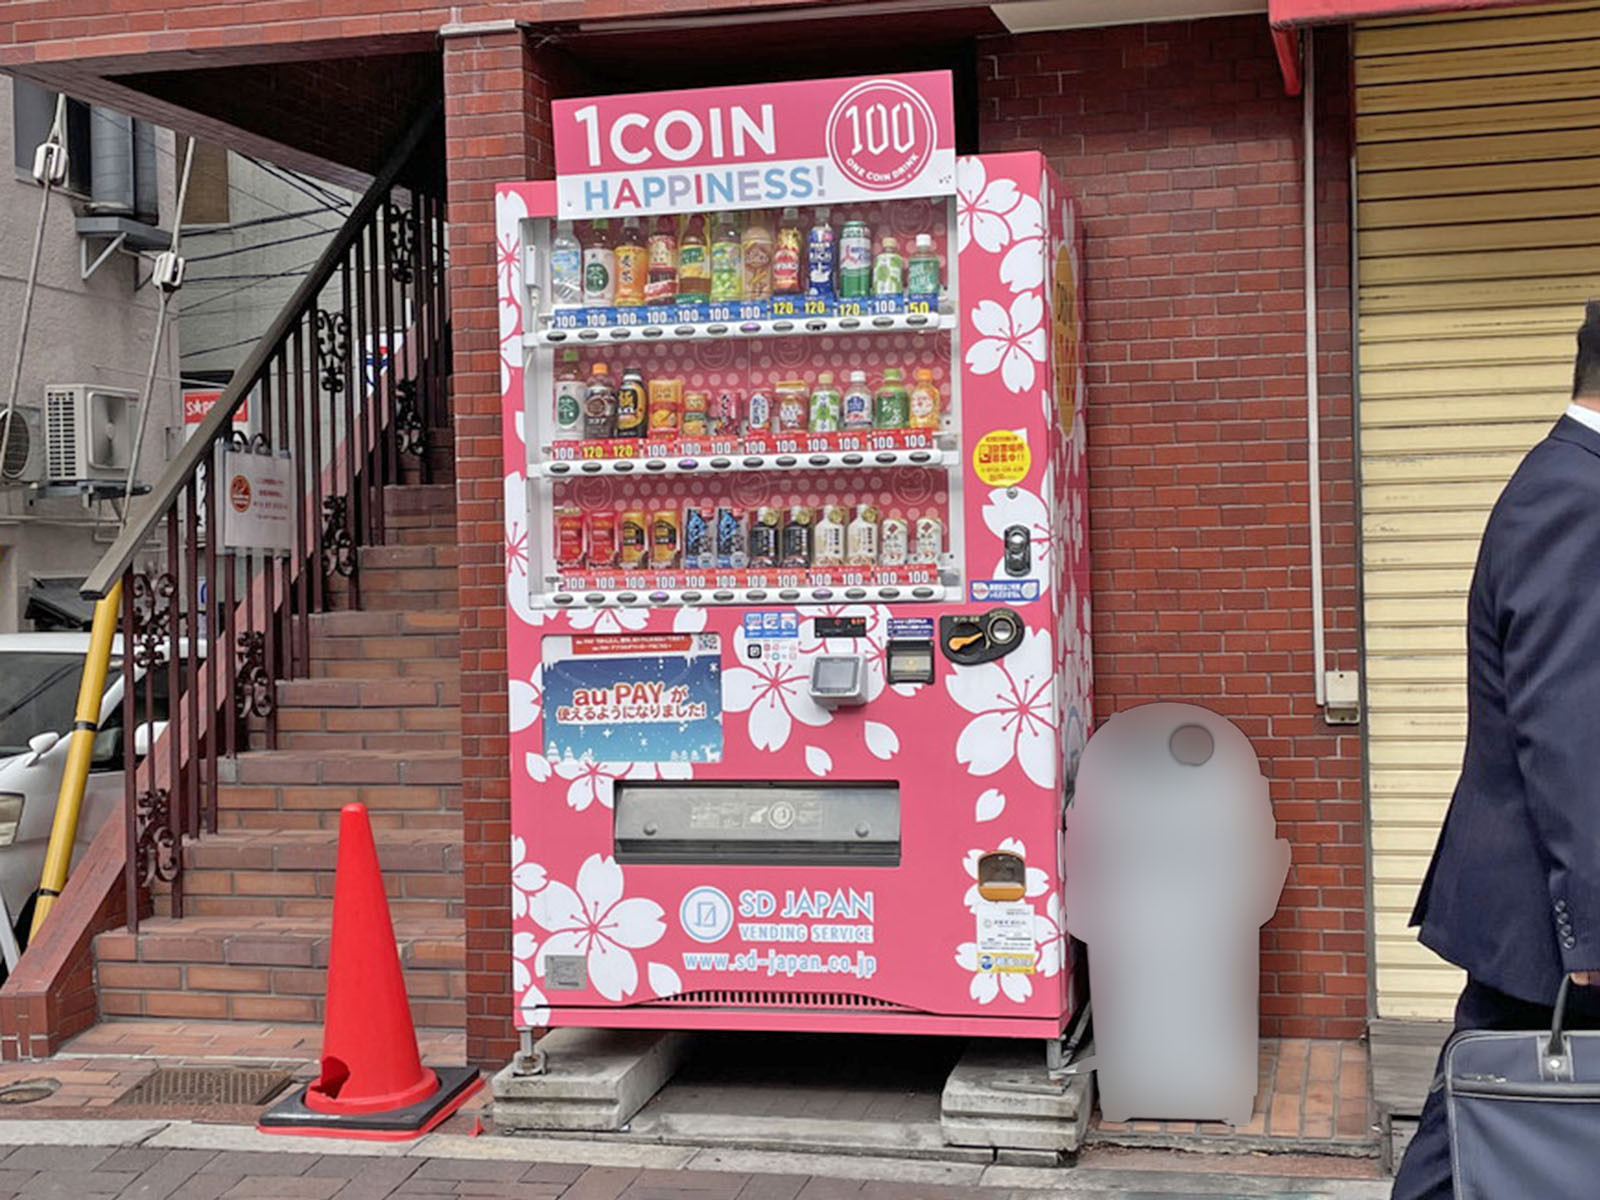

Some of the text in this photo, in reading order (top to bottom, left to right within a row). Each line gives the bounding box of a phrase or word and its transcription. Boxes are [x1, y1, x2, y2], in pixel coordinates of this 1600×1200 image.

[845, 101, 915, 156] 100
[846, 154, 919, 182] ONE COIN DRINK
[585, 167, 825, 211] HAPPINESS!
[740, 306, 760, 318] 100
[773, 302, 793, 314] 120
[804, 301, 825, 313] 120
[840, 304, 860, 316] 120
[874, 300, 896, 312] 100
[910, 302, 930, 314] 50
[586, 314, 607, 326] 100
[616, 313, 637, 324] 100
[647, 312, 667, 323] 100
[678, 310, 698, 321] 100
[709, 309, 729, 320] 100
[556, 316, 577, 328] 100
[776, 440, 797, 452] 100
[807, 439, 828, 450] 100
[839, 438, 859, 449] 100
[873, 436, 894, 449] 100
[904, 435, 926, 447] 100
[554, 448, 574, 459] 100
[583, 447, 603, 458] 120
[613, 446, 632, 457] 120
[648, 444, 667, 456] 100
[680, 444, 700, 455] 100
[711, 442, 730, 454] 100
[744, 442, 766, 454] 100
[596, 577, 615, 588] 100
[626, 577, 646, 588] 100
[656, 576, 676, 588] 100
[686, 576, 706, 587] 100
[716, 575, 736, 587] 100
[747, 575, 767, 587] 100
[778, 575, 798, 586] 100
[811, 574, 832, 585] 100
[842, 573, 863, 585] 100
[877, 572, 897, 584] 100
[908, 571, 929, 583] 100
[566, 578, 586, 589] 100
[574, 682, 689, 706] au PAY が
[557, 703, 706, 721] 使えるようになりました!
[740, 889, 873, 921] SD JAPAN
[740, 925, 873, 942] VENDING SERVICE
[683, 949, 877, 978] www.sd-japan.co.jp
